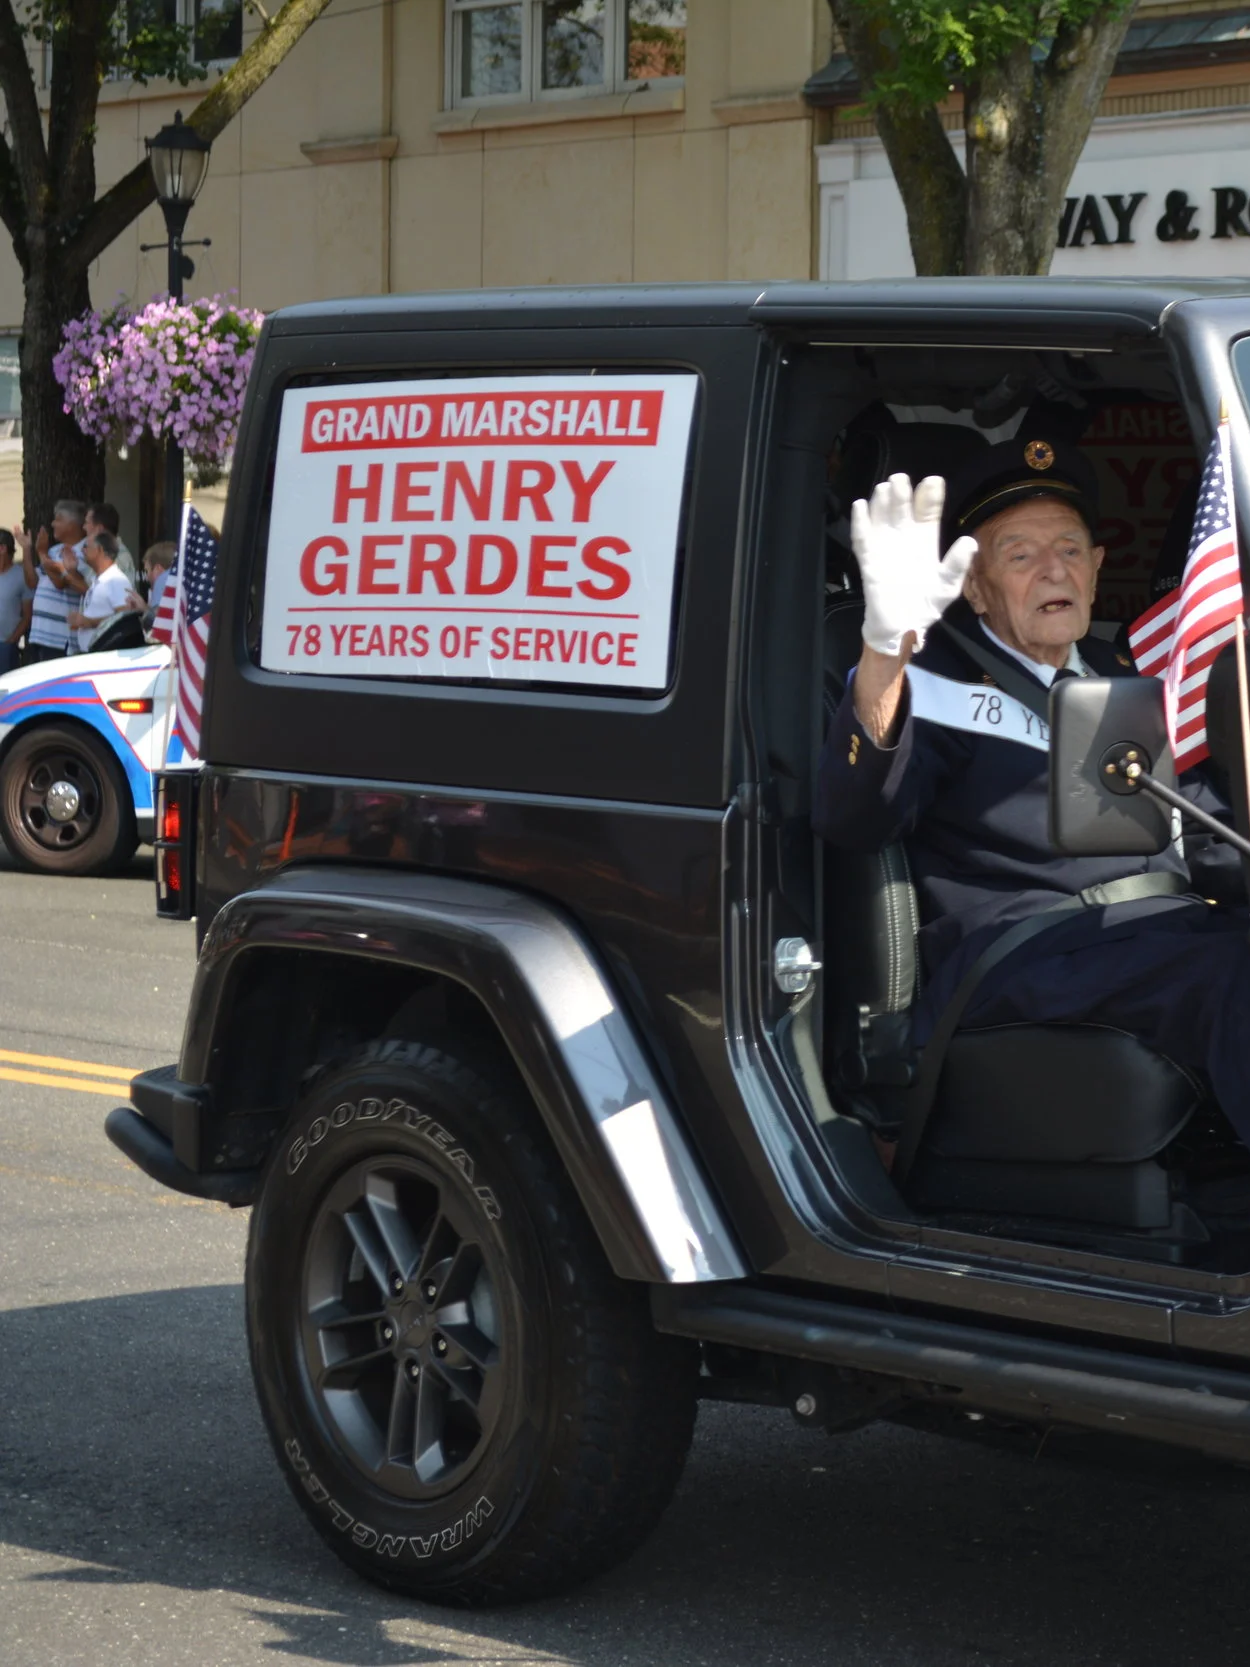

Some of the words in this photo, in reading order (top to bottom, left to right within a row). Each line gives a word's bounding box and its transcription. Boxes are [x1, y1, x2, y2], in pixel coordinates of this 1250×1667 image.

[1155, 189, 1199, 242] &
[311, 402, 431, 443] GRAND
[440, 399, 649, 438] MARSHALL
[332, 460, 617, 523] HENRY
[299, 534, 632, 601] GERDES
[286, 625, 321, 656] 78
[330, 624, 429, 658] YEARS
[440, 626, 483, 659] OF
[490, 627, 638, 667] SERVICE
[970, 693, 1002, 725] 78
[287, 1097, 500, 1221] GOODYEAR
[284, 1438, 495, 1558] WRANGLER
